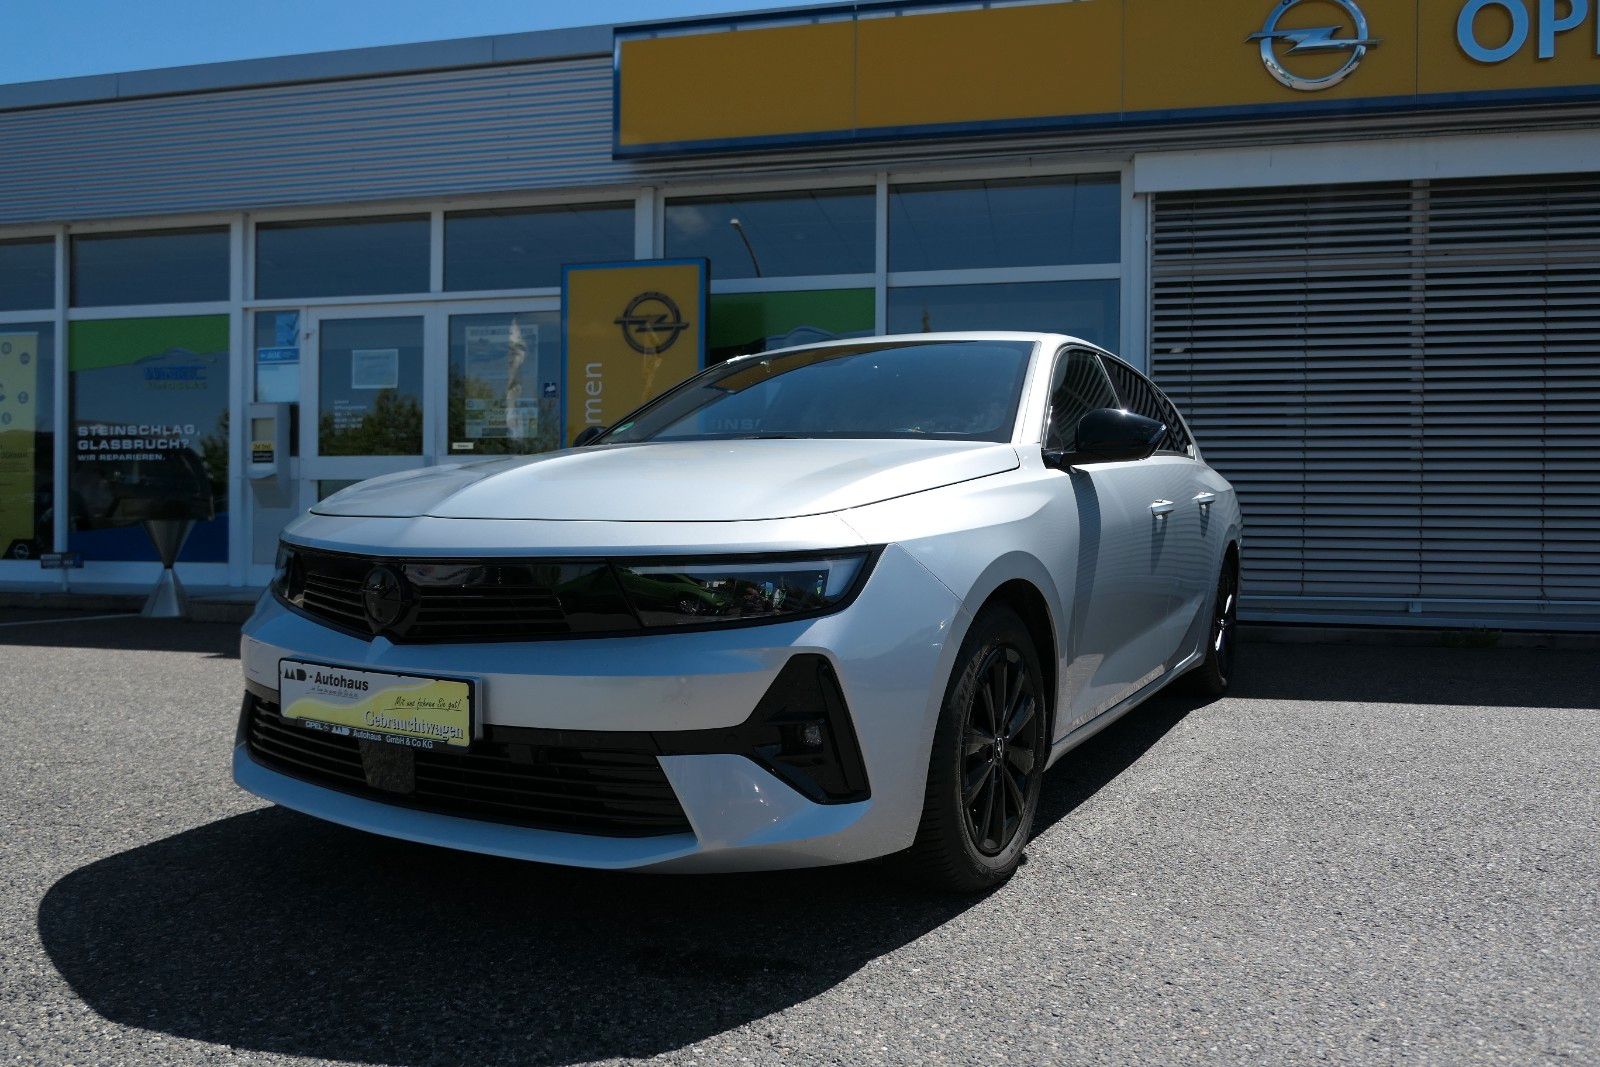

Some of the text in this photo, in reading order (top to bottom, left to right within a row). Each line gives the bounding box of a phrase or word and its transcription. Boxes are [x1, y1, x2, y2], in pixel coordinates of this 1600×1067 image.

[1457, 0, 1600, 62] OP
[78, 424, 200, 436] STEINSCHLAG,
[78, 439, 190, 450] GLASBRUCH?
[314, 671, 369, 691] Autohaus
[364, 710, 464, 741] Gebrauchtwagen
[352, 729, 382, 741] Autohaus
[386, 735, 405, 745] GmbH
[406, 737, 411, 746] &
[411, 738, 422, 747] Co
[422, 739, 433, 749] KG
